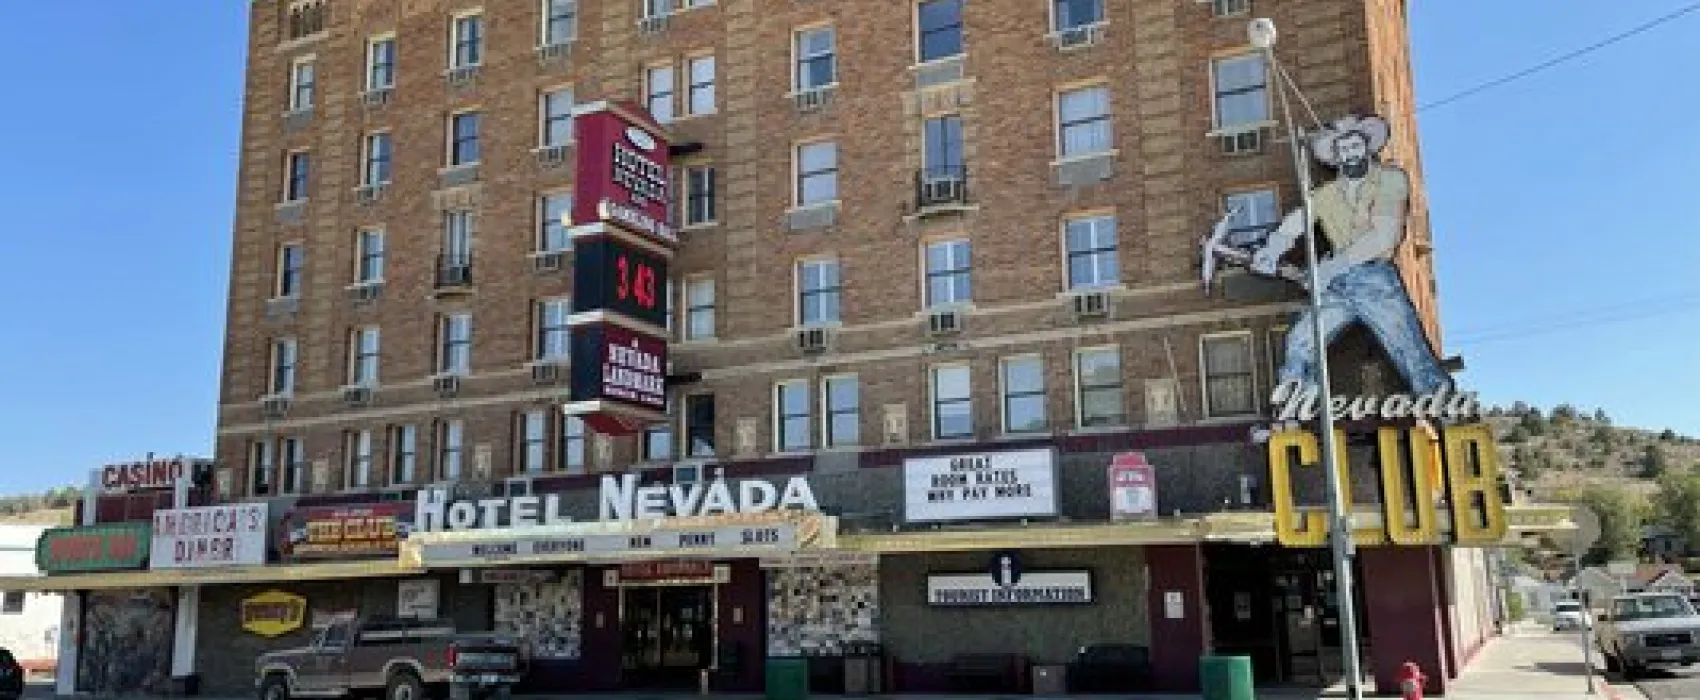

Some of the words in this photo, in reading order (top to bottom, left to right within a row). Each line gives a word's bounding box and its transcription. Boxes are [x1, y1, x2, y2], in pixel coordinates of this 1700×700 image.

[612, 142, 665, 181] HOTEL
[608, 342, 661, 374] NEVADA
[602, 362, 665, 397] LANDMARK
[1270, 378, 1480, 422] Nevada
[930, 472, 967, 488] ROOM
[975, 468, 1018, 486] RATES
[950, 456, 992, 472] GREAT
[927, 489, 955, 504] WHY
[962, 486, 988, 502] PAY
[994, 483, 1031, 498] MORE
[1269, 423, 1507, 548] CLUB
[415, 488, 574, 532] HOTEL
[600, 470, 820, 520] NEVADA
[174, 537, 234, 564] DINER
[471, 540, 518, 556] WELCOME
[532, 538, 585, 553] EVERYONE
[628, 535, 652, 549] NEW
[678, 532, 716, 547] PENNY
[740, 528, 780, 546] SLOTS
[933, 587, 990, 603] TOURIST
[991, 585, 1085, 602] INFORMATION
